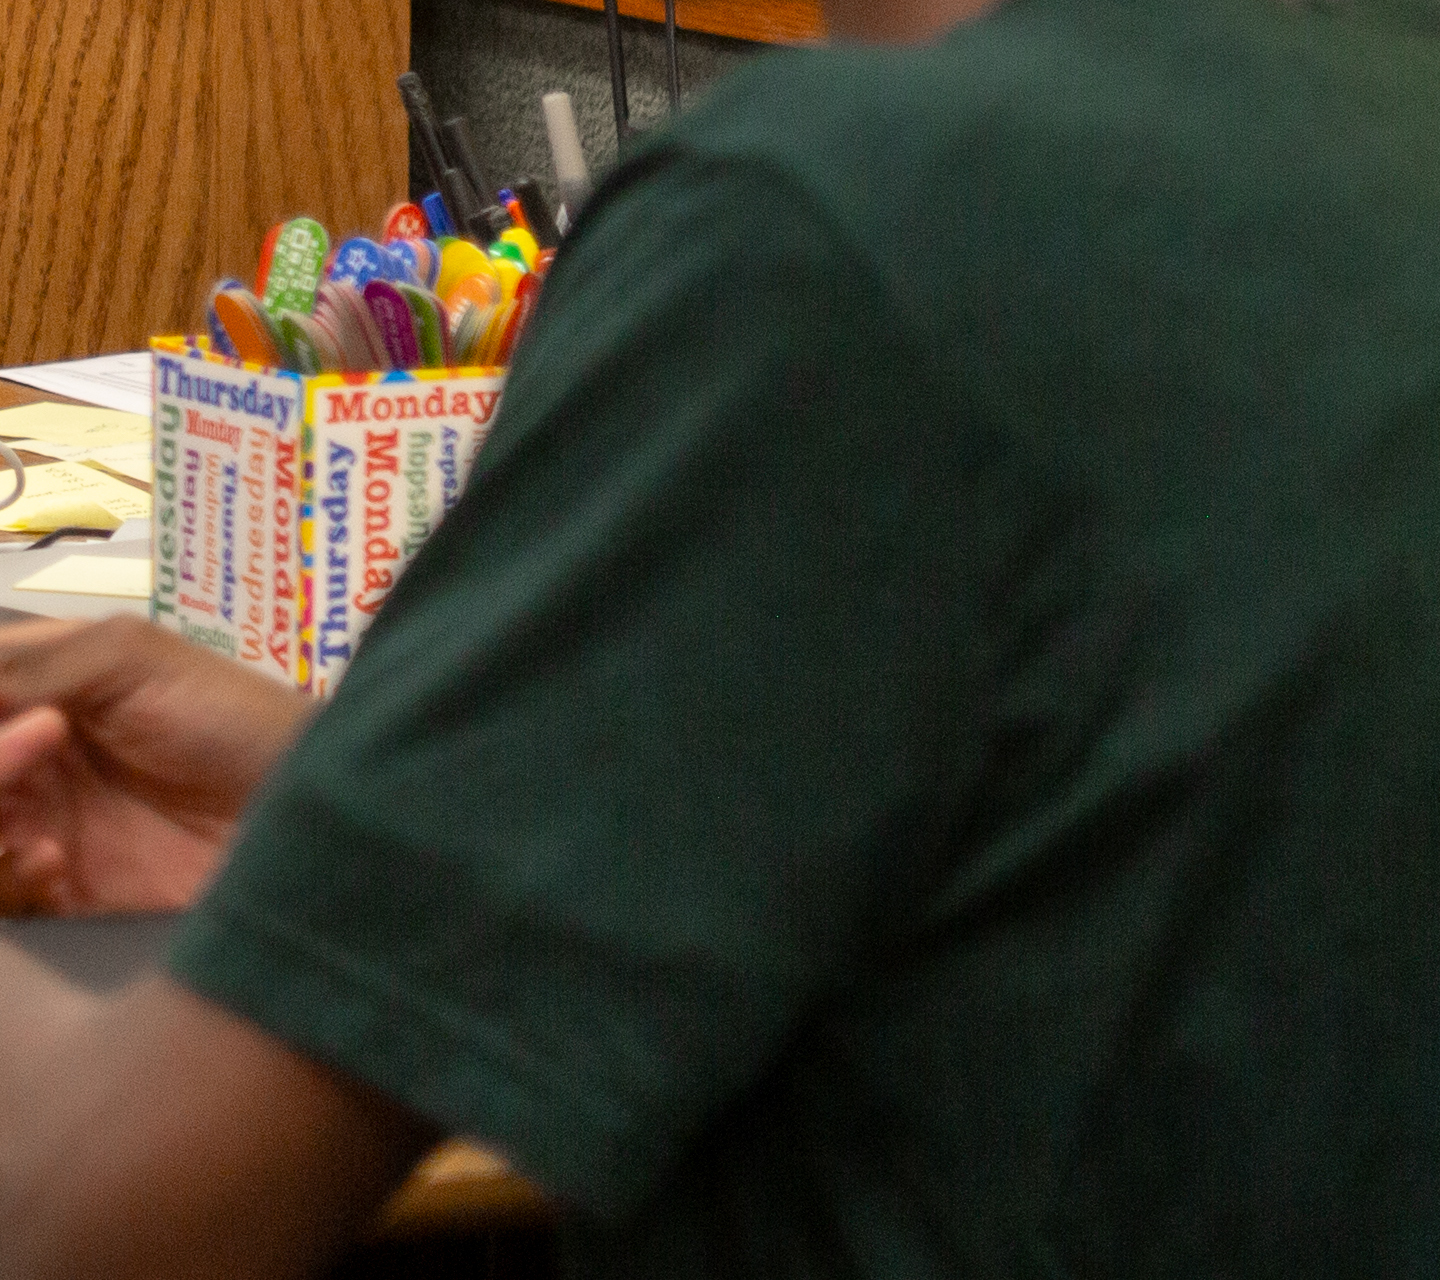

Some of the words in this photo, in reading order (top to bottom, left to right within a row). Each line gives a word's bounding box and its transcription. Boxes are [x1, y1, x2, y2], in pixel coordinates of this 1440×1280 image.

[158, 357, 295, 432] Thursday
[325, 386, 502, 425] Monday
[154, 403, 182, 624] Tuesday
[240, 425, 272, 661] Wednesday
[266, 437, 297, 675] Monday
[318, 439, 356, 667] Thursday
